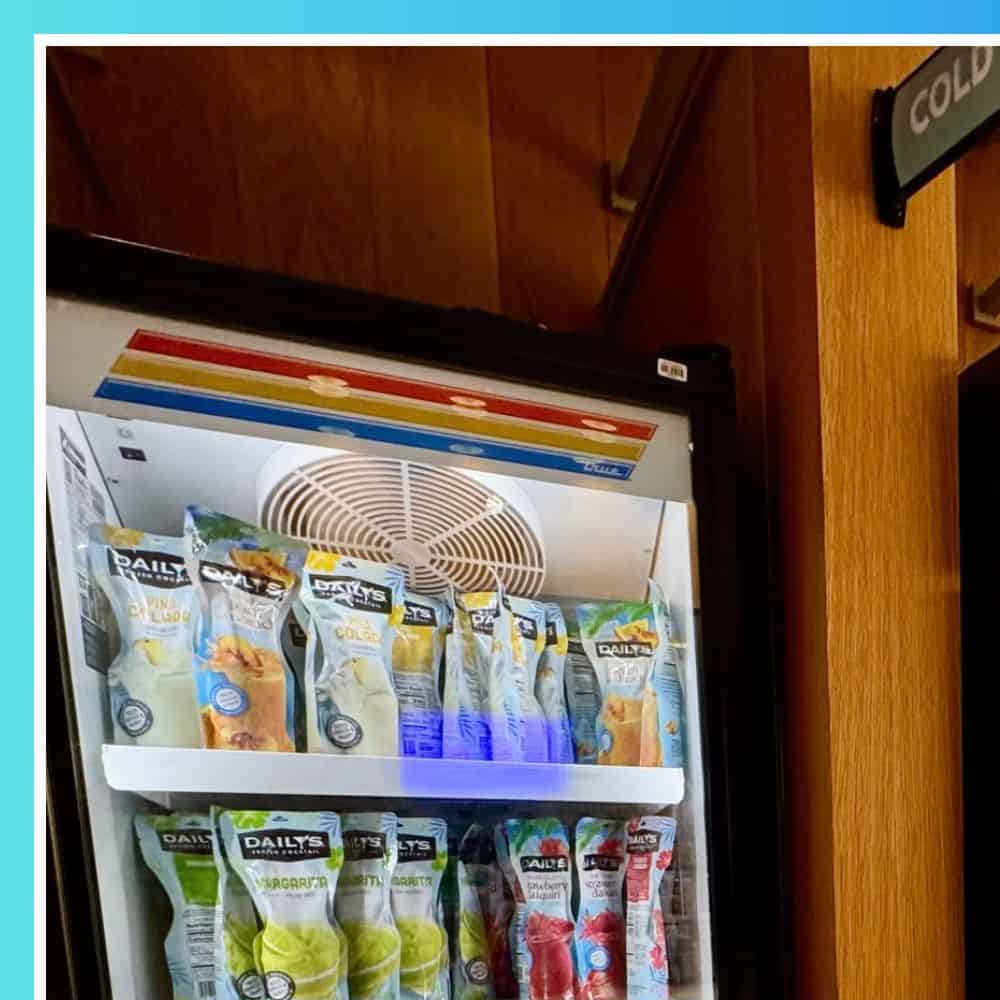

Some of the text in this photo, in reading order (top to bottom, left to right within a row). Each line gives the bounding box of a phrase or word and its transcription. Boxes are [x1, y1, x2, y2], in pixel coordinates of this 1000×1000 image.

[910, 46, 993, 135] COLD
[113, 554, 186, 576] DAILY
[162, 833, 213, 844] DAILY
[244, 834, 324, 850] DAILY'S
